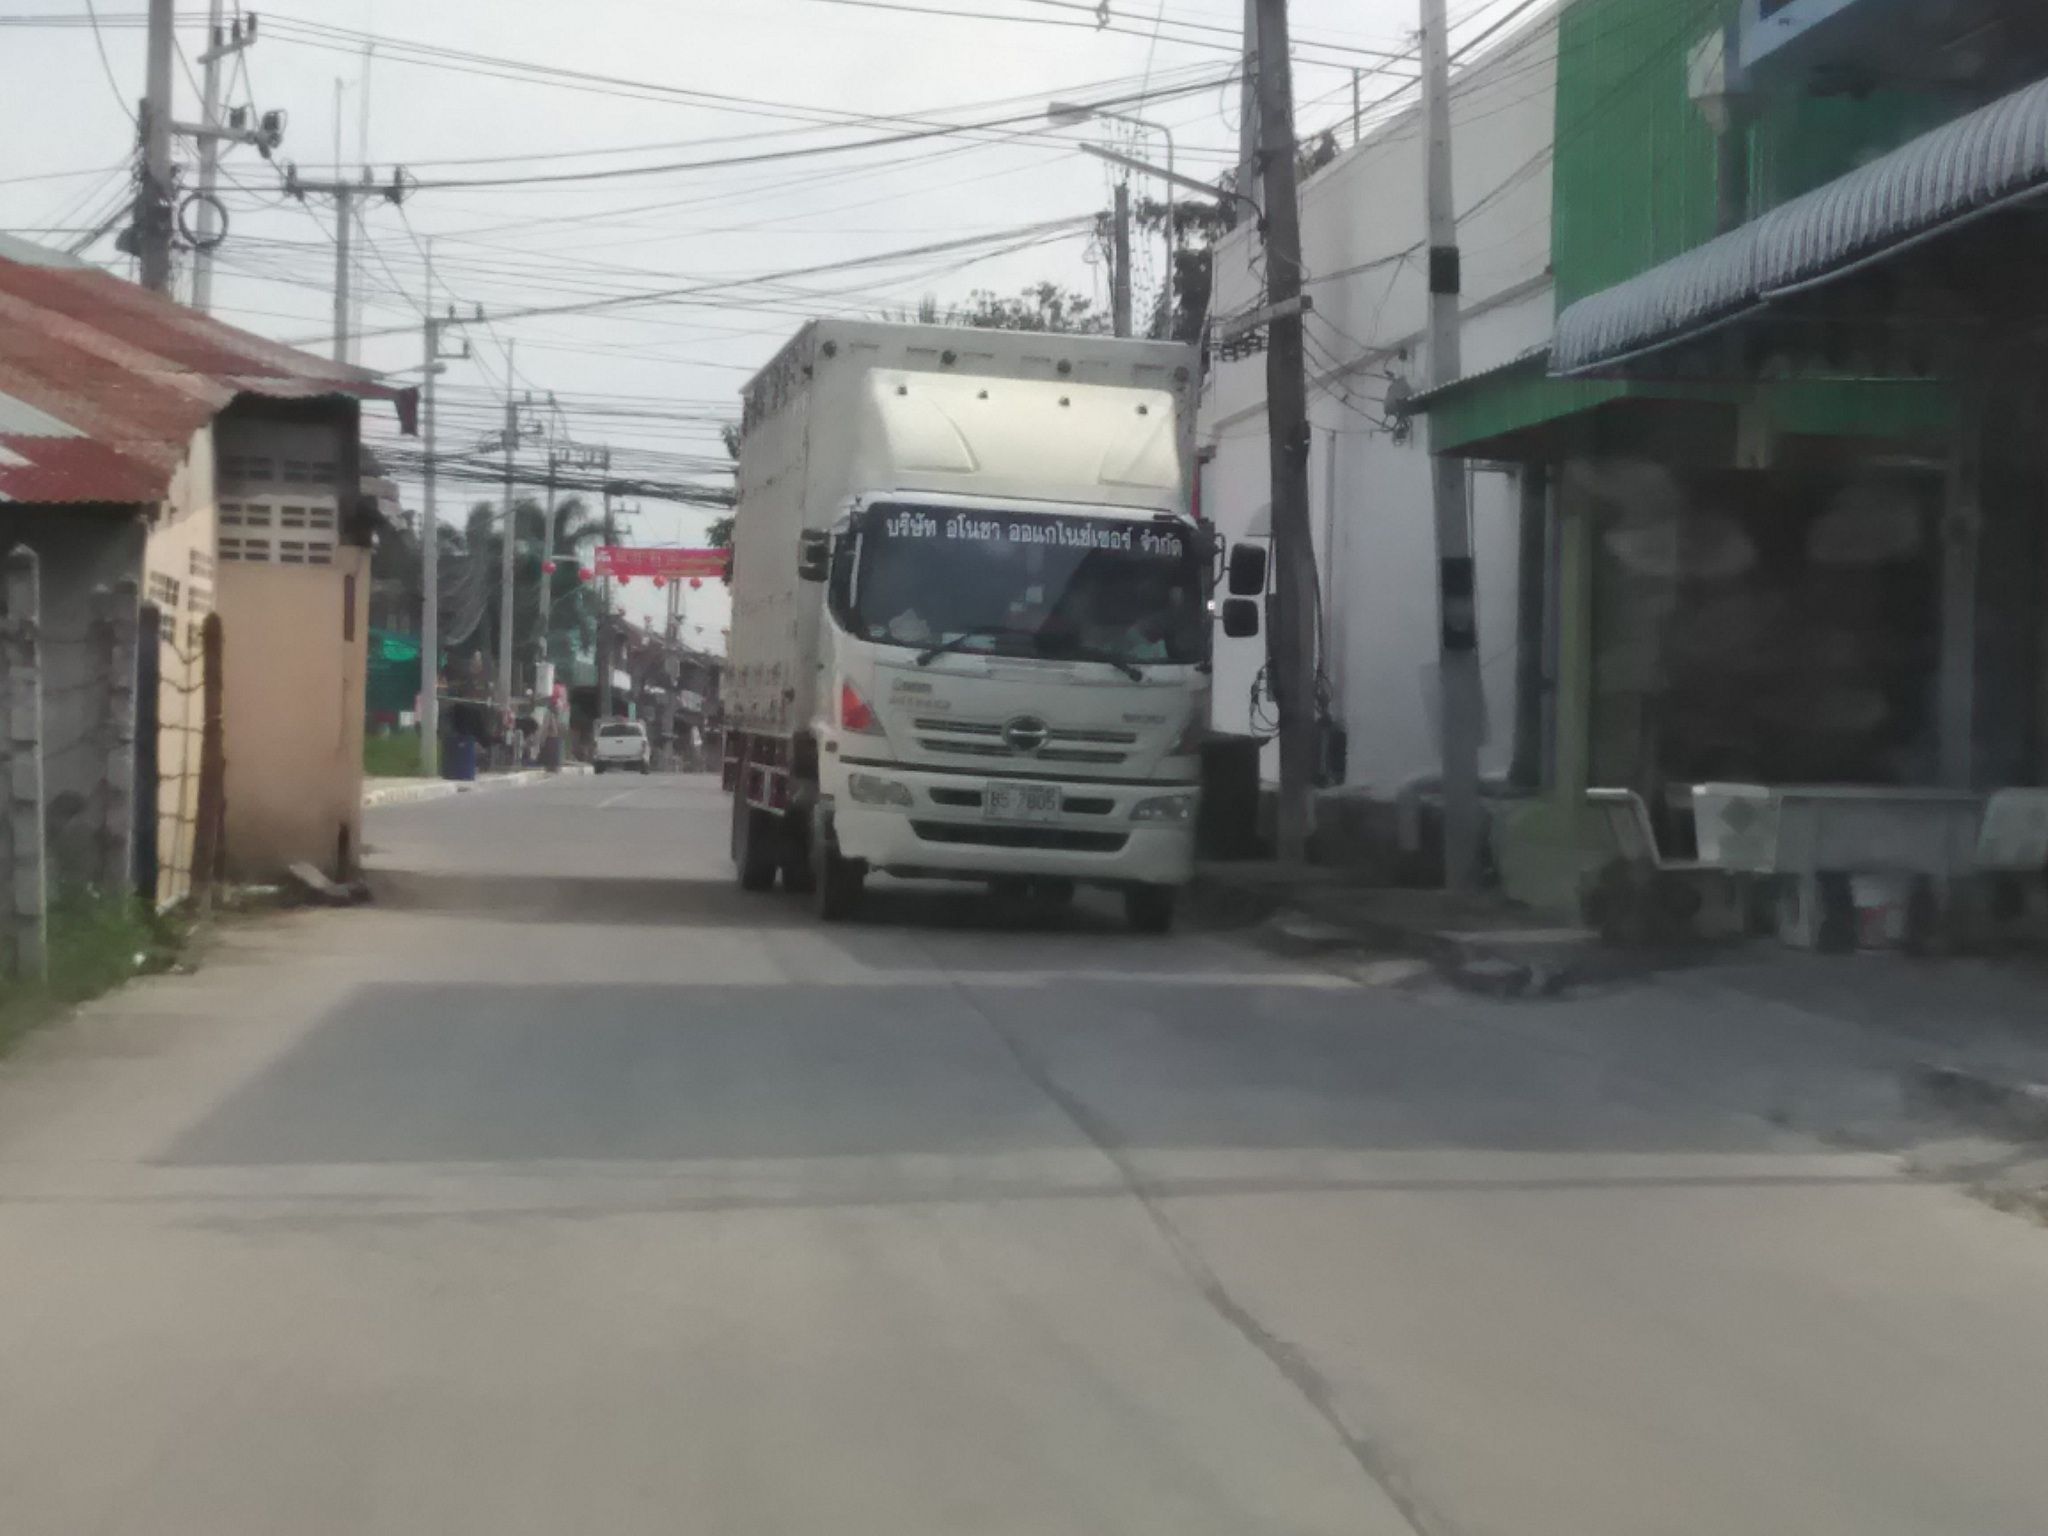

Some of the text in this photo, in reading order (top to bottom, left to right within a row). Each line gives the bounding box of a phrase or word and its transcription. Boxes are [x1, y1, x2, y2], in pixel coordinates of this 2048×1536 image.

[886, 510, 937, 538] บริษัท
[1140, 528, 1184, 558] จำกัด
